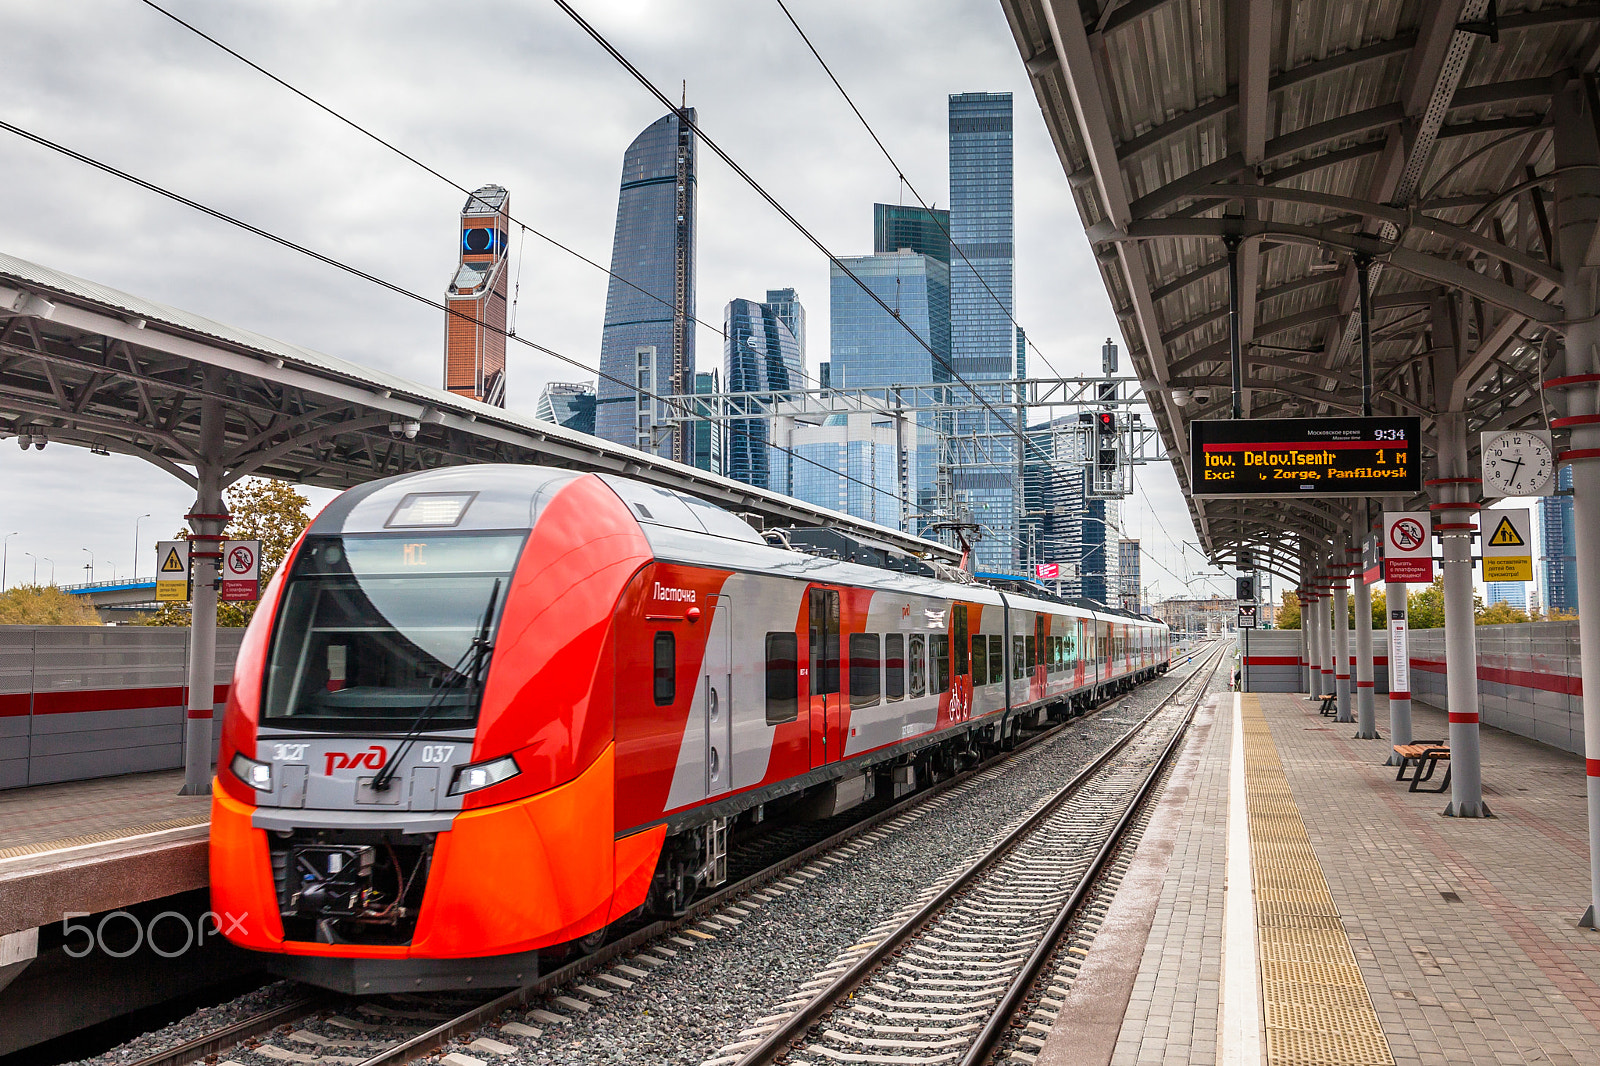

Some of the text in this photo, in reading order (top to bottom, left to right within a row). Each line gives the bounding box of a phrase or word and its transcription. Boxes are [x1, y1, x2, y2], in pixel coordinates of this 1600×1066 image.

[1374, 428, 1405, 441] 9:34
[1375, 449, 1386, 464] 1
[1204, 469, 1235, 480] Exc:
[1273, 468, 1321, 480] Zorge,
[653, 581, 696, 603] Ласточка
[422, 745, 456, 763] 037
